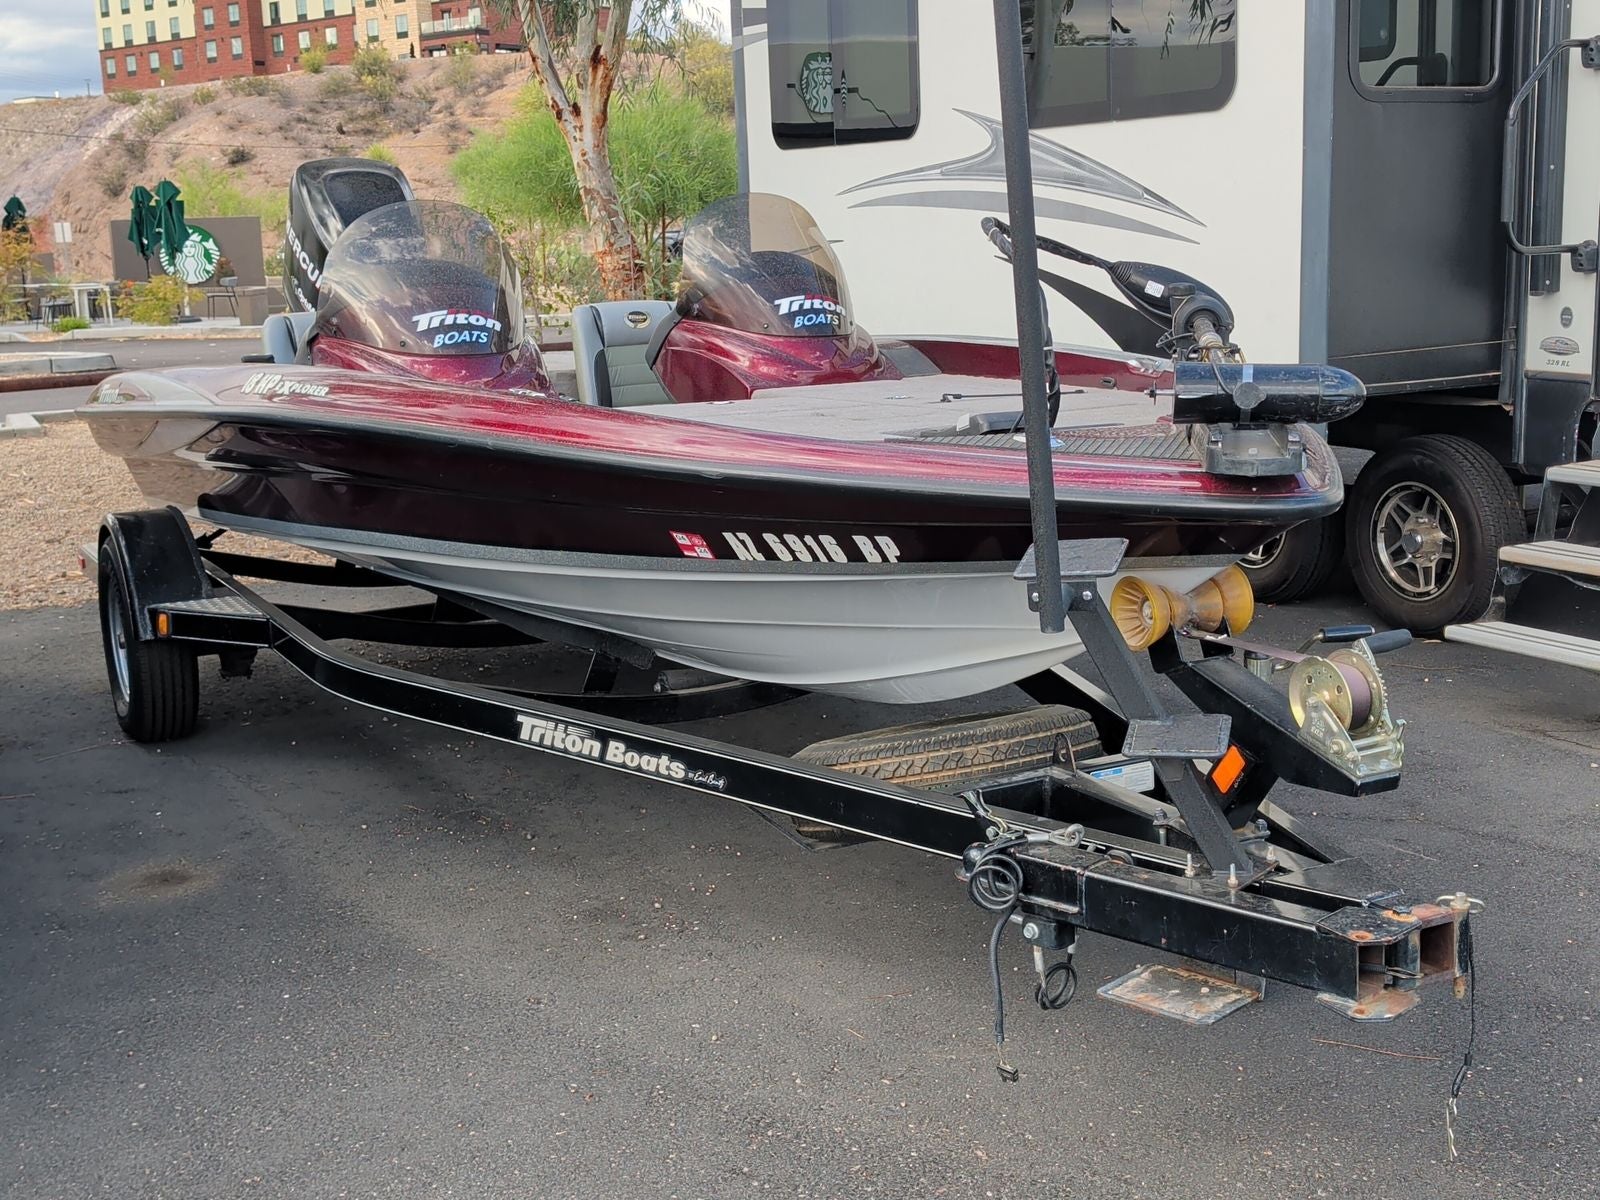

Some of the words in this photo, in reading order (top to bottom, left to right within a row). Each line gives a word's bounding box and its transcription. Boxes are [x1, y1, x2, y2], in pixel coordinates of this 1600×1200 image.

[774, 295, 846, 316] Triton
[411, 309, 502, 333] Triton
[794, 314, 839, 328] BOATS
[433, 331, 488, 348] BOATS
[722, 532, 767, 561] AZ
[762, 533, 848, 563] 6916
[851, 535, 901, 563] BP
[516, 714, 602, 758] Triton
[605, 740, 686, 779] Boats
